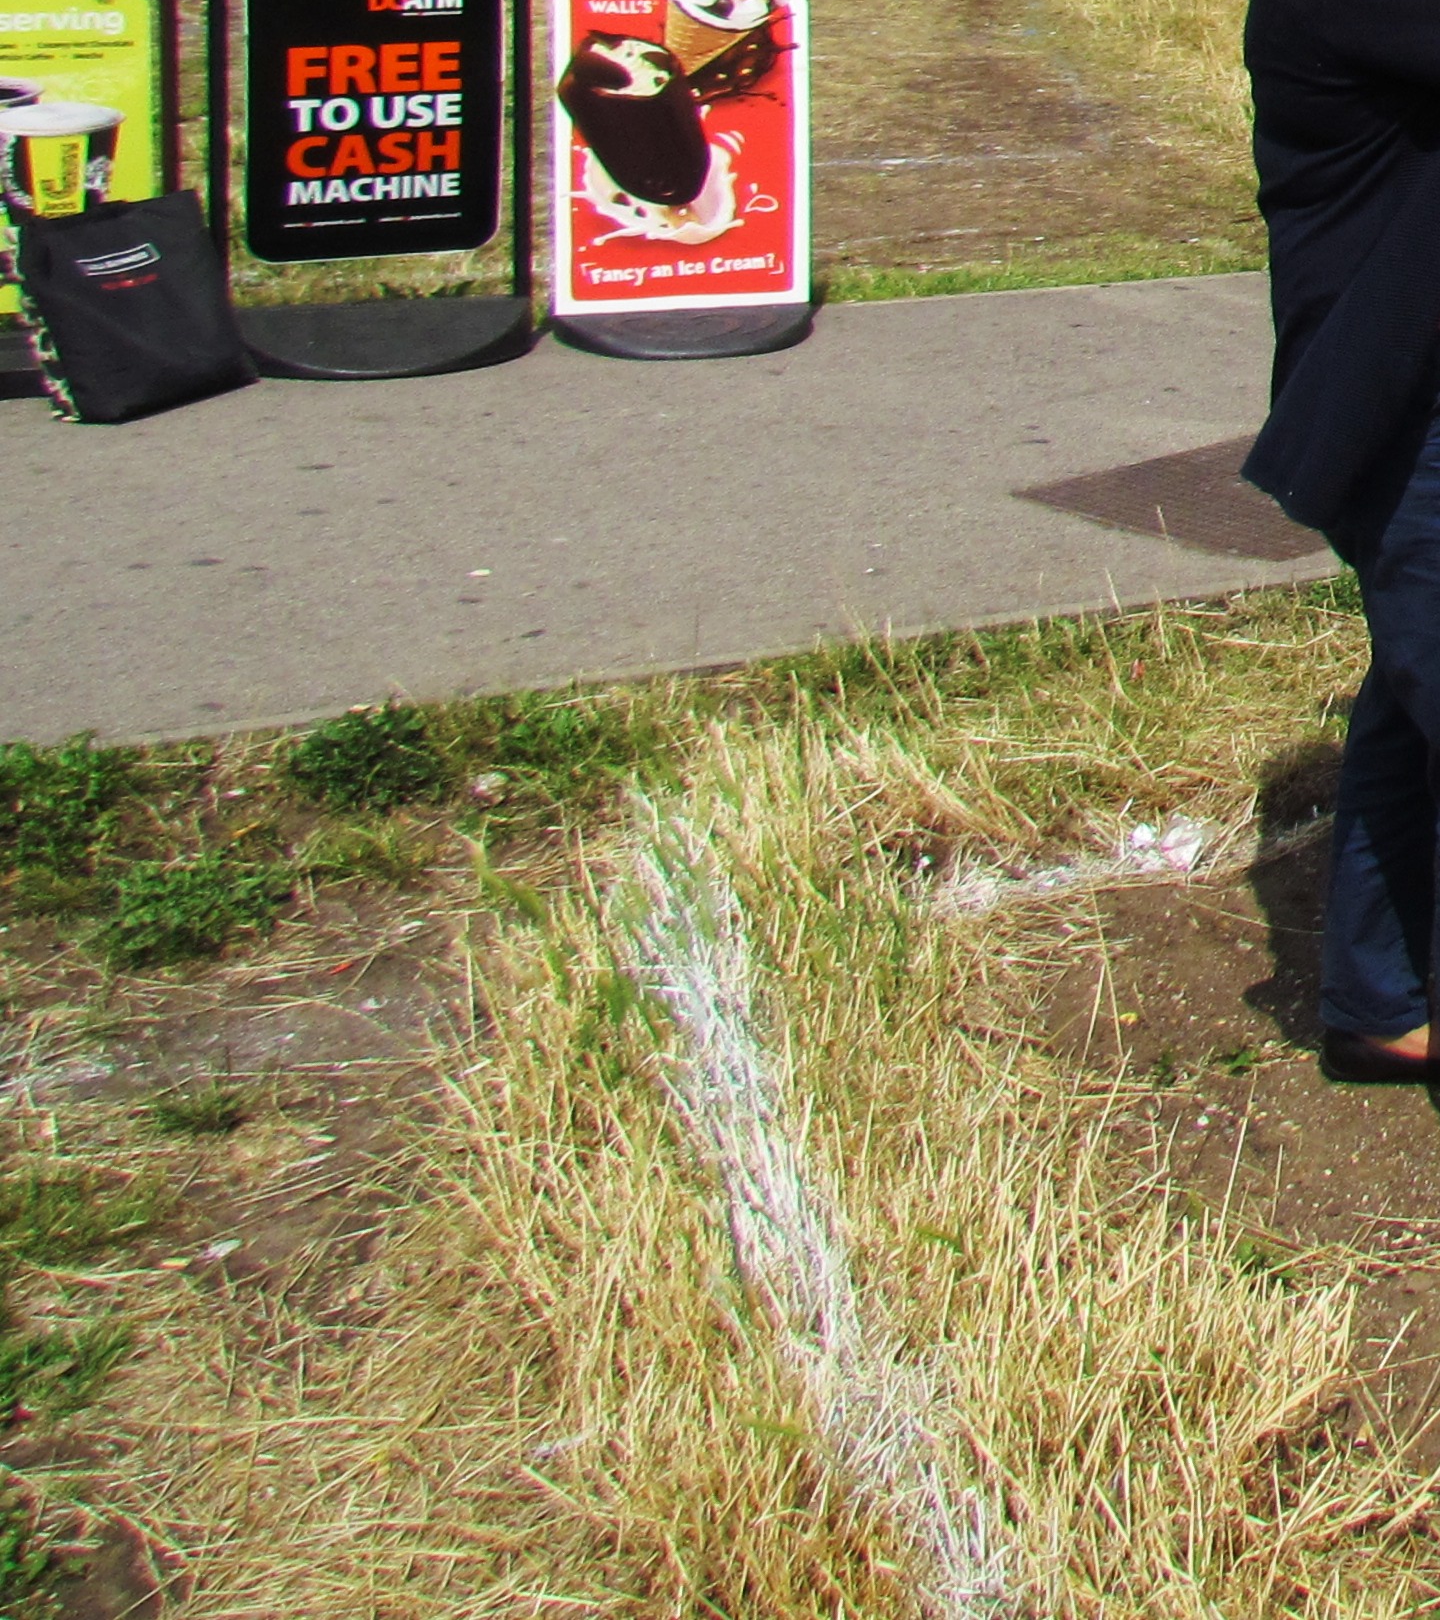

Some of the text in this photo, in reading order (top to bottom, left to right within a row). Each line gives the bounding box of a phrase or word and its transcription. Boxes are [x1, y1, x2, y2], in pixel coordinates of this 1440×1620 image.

[0, 7, 126, 35] serving
[588, 0, 653, 15] WALL'S
[286, 41, 463, 97] FREE
[288, 93, 463, 133] TO USE
[285, 130, 462, 179] CASH
[286, 172, 462, 207] MACHINE
[590, 253, 776, 287] Fancy an Ice Cream?
